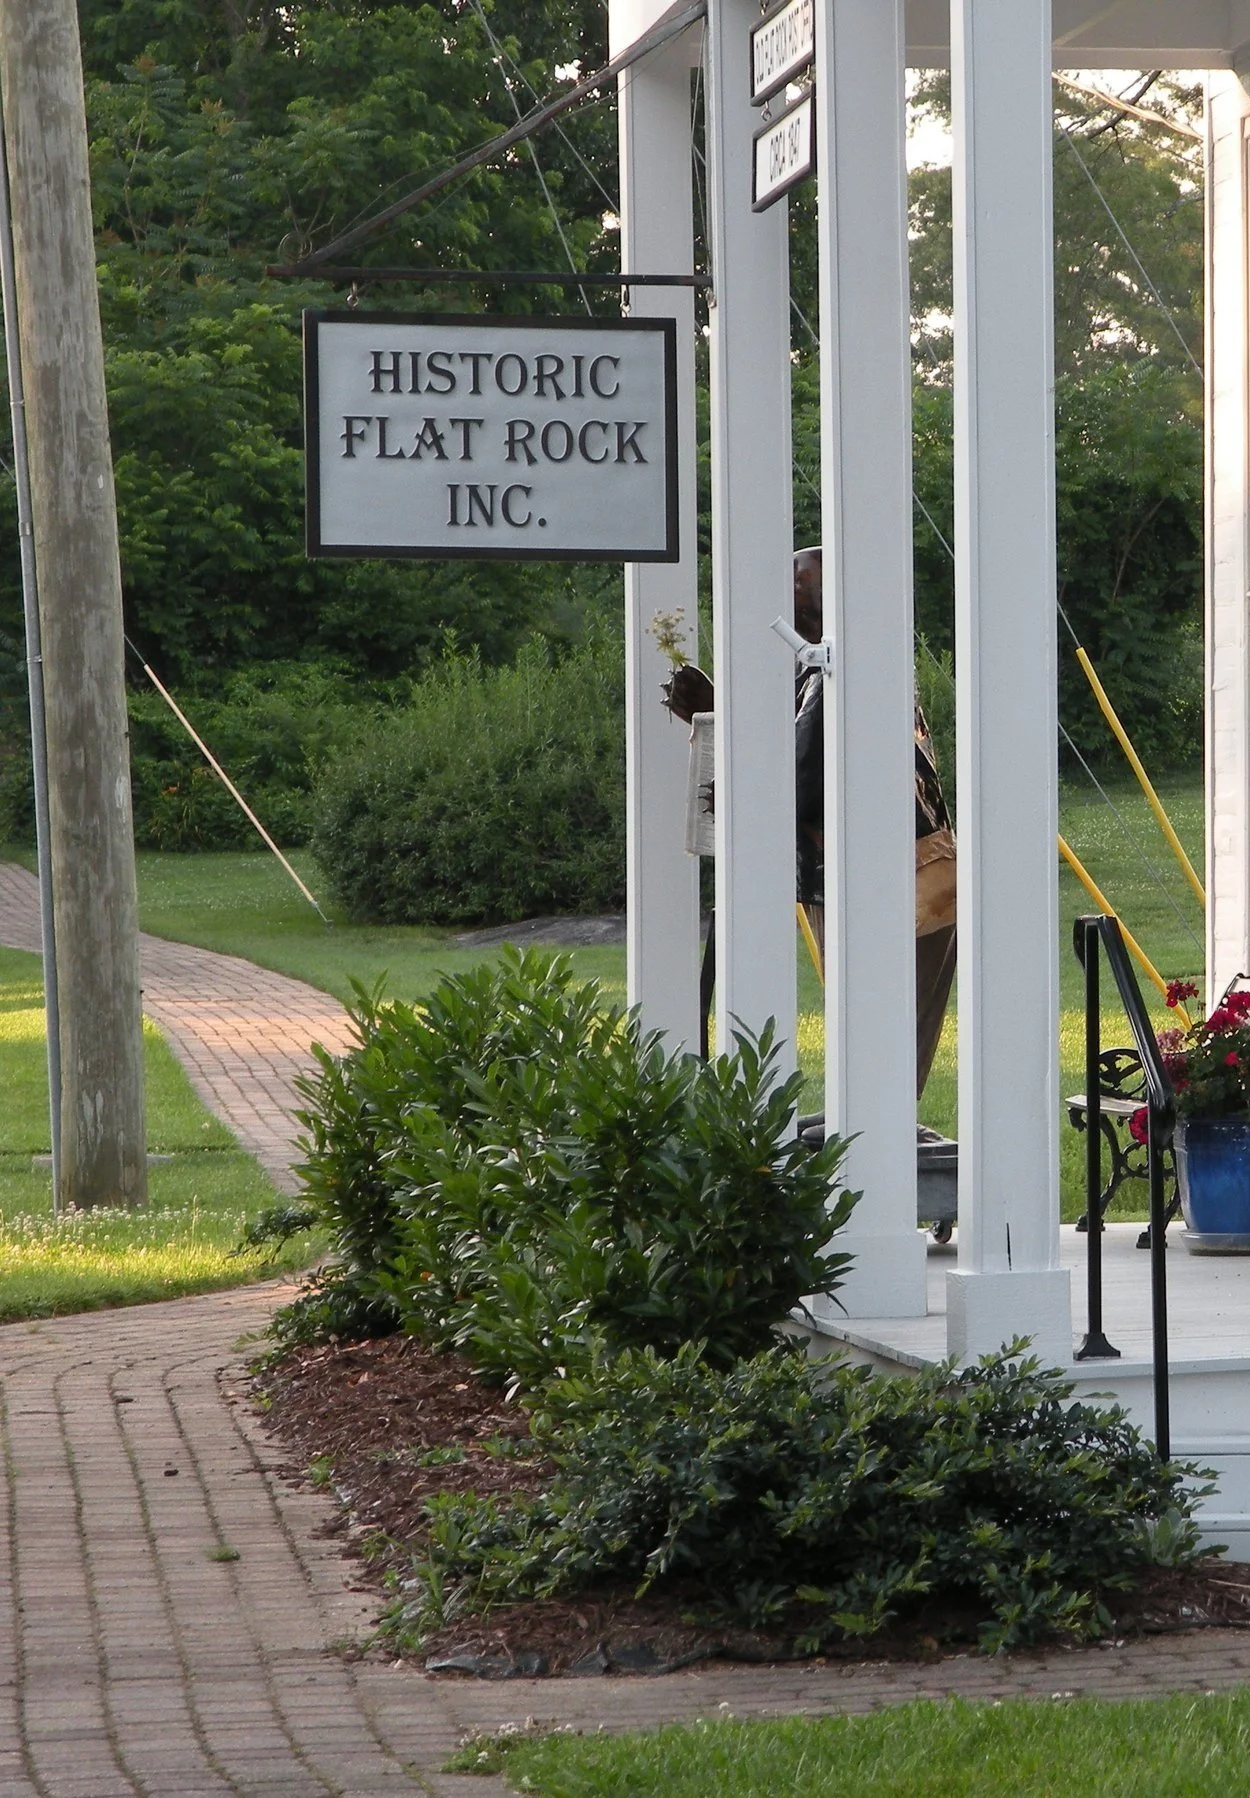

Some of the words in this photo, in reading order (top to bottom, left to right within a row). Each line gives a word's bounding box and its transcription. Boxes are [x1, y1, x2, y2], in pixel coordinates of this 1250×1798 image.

[368, 350, 621, 402] HISTORIC
[340, 415, 485, 461] FLAT
[503, 419, 649, 467] ROCK
[446, 483, 548, 529] INC.
